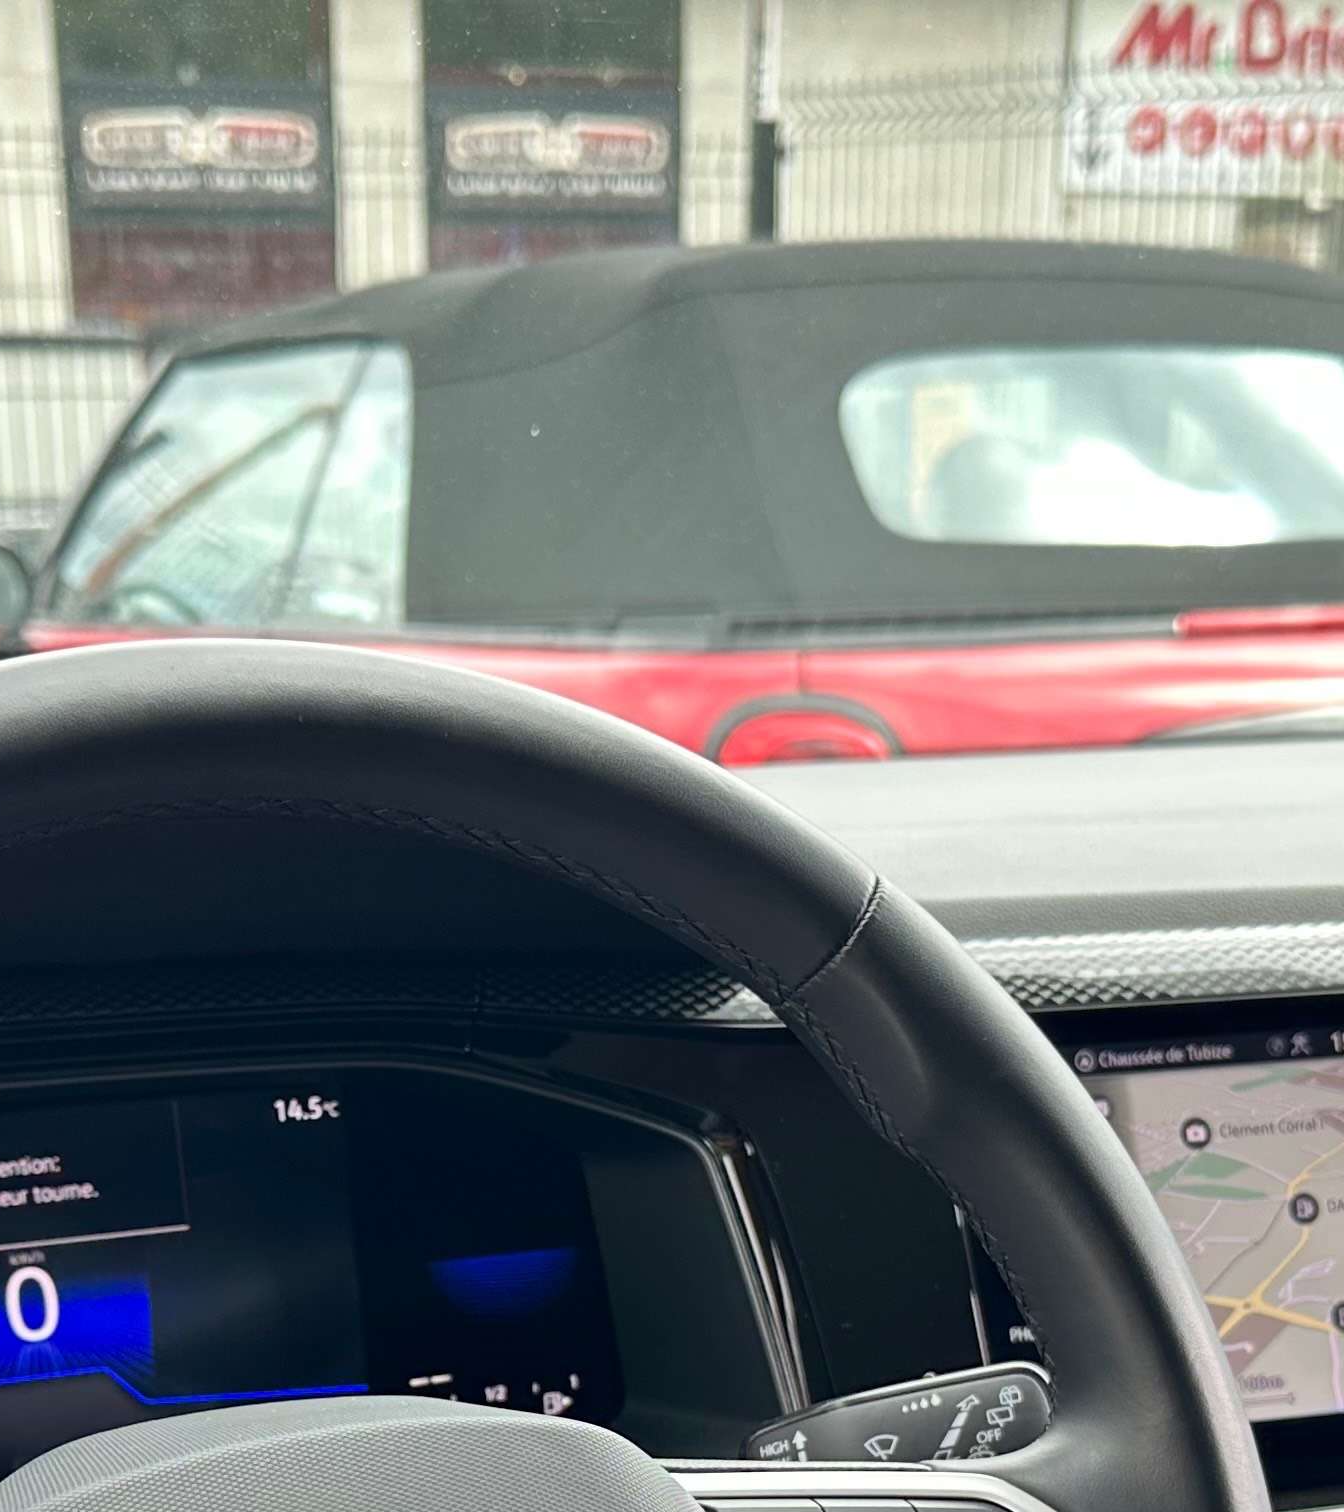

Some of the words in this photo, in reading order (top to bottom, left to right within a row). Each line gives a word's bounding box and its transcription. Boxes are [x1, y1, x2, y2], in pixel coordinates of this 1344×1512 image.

[1165, 1046, 1184, 1063] de
[5, 1265, 60, 1343] 0
[975, 1427, 1003, 1446] OFF
[759, 1440, 790, 1459] HIGH
